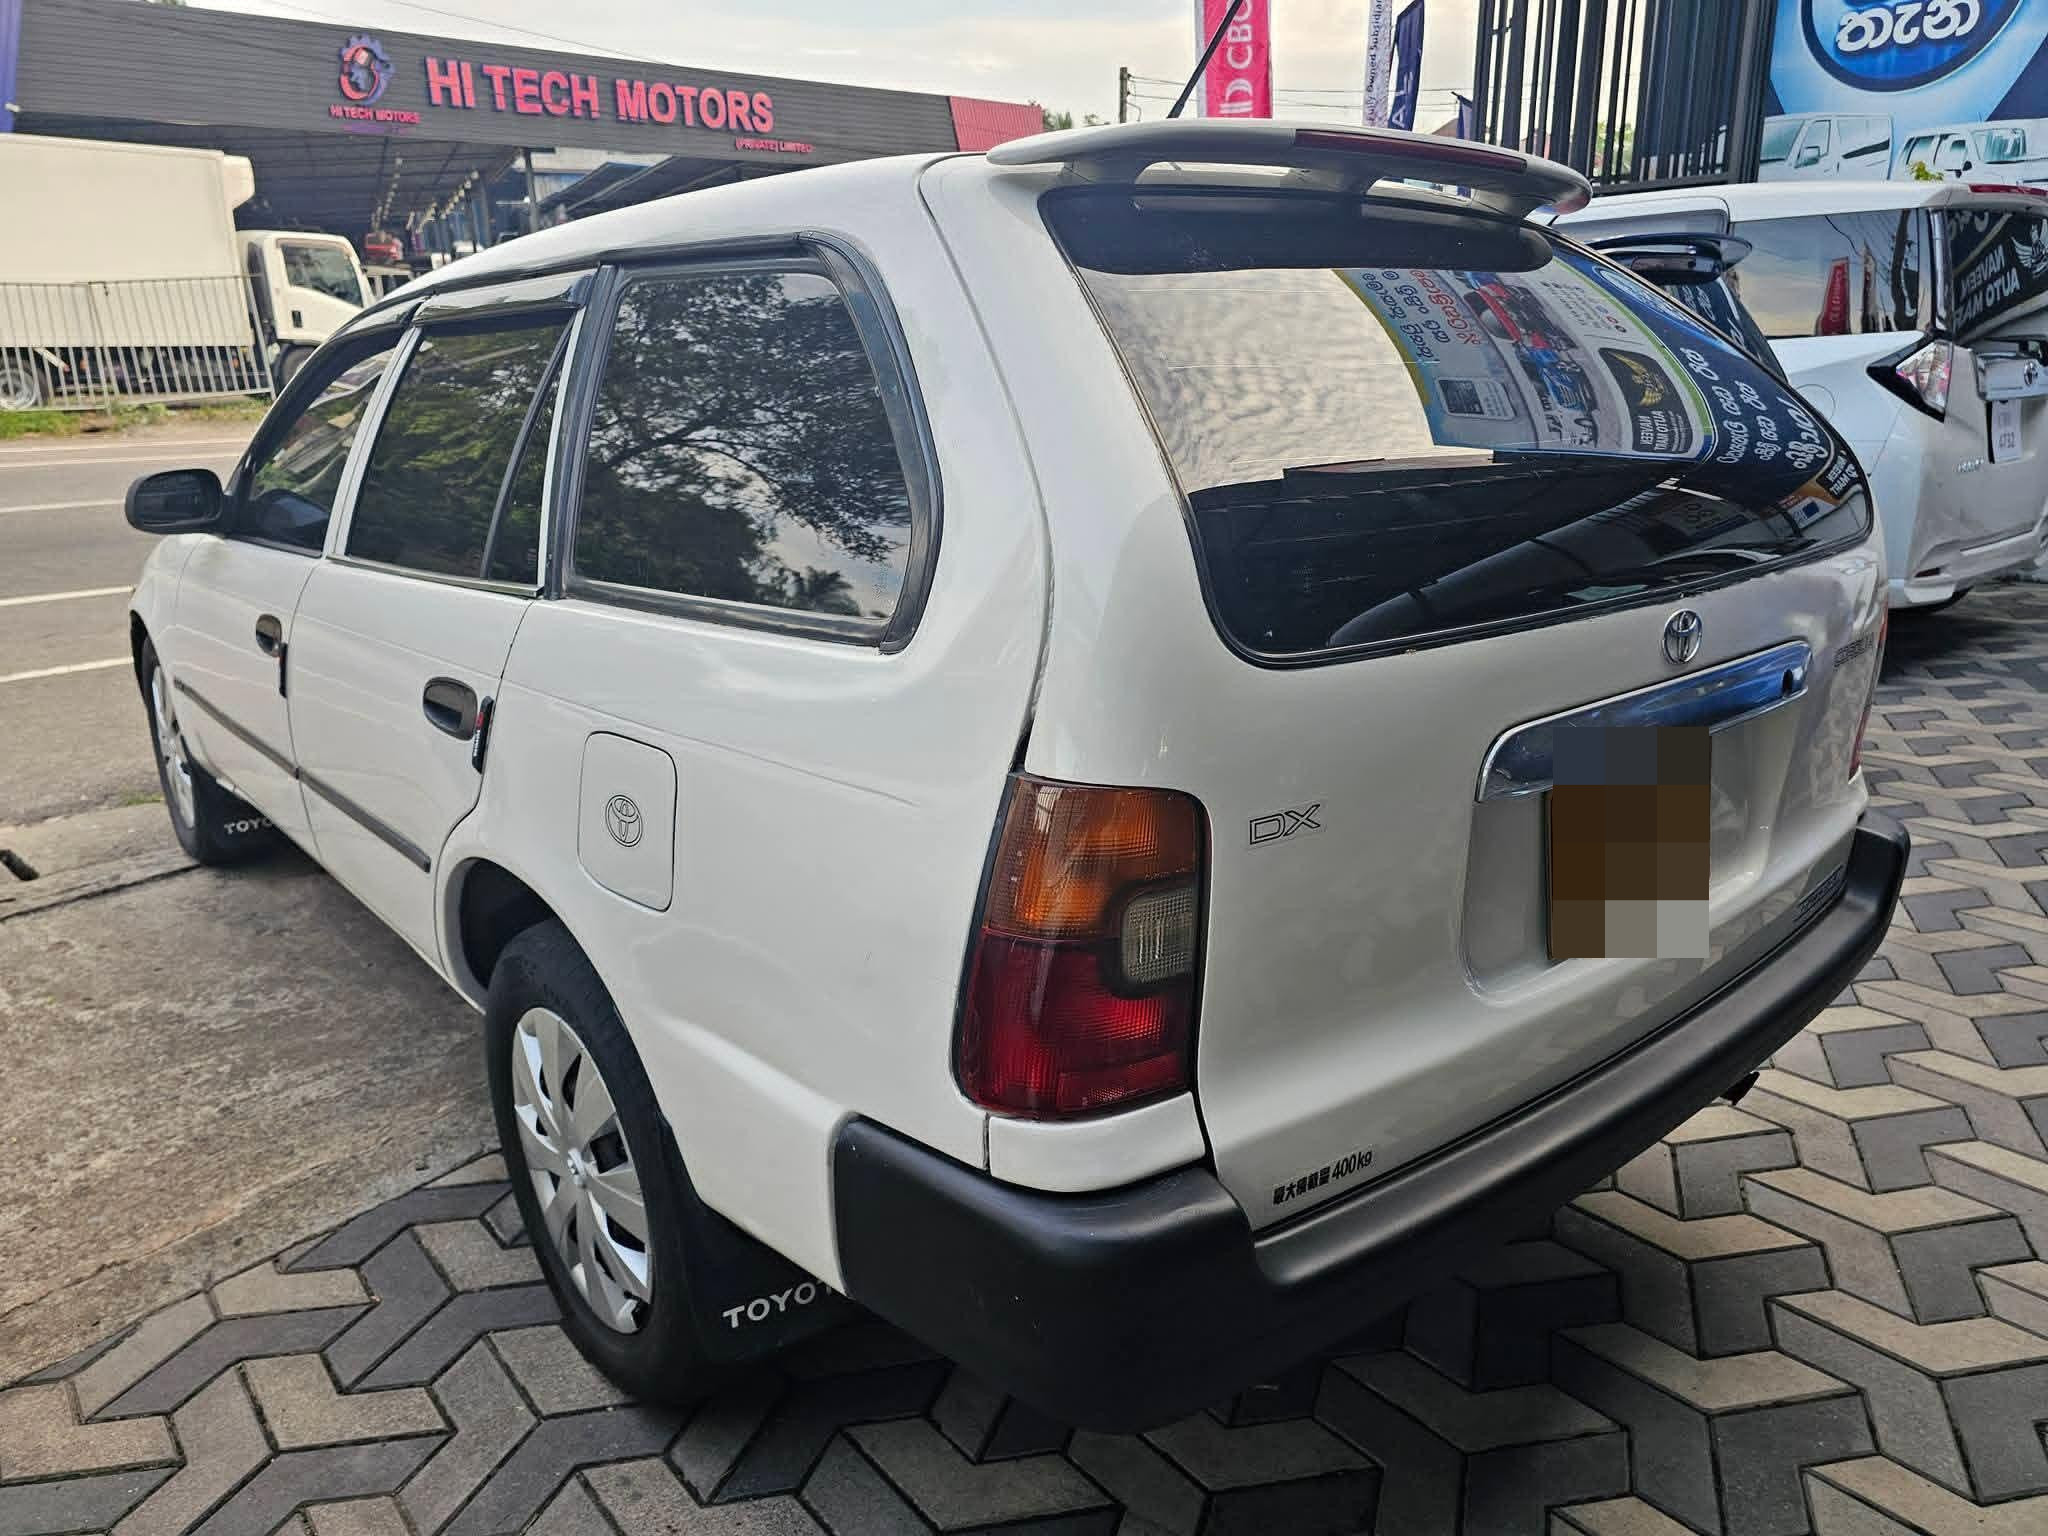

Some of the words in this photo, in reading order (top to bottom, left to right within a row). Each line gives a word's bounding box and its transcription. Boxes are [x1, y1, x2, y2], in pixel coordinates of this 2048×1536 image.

[1367, 54, 1377, 93] Owned
[343, 105, 373, 121] TECH
[374, 109, 422, 125] MOTORS
[425, 56, 475, 109] HI
[483, 64, 600, 120] TECH
[614, 78, 774, 134] MOTORS
[223, 818, 273, 835] TOYO
[1249, 803, 1321, 845] DX
[722, 1280, 832, 1329] TOYO
